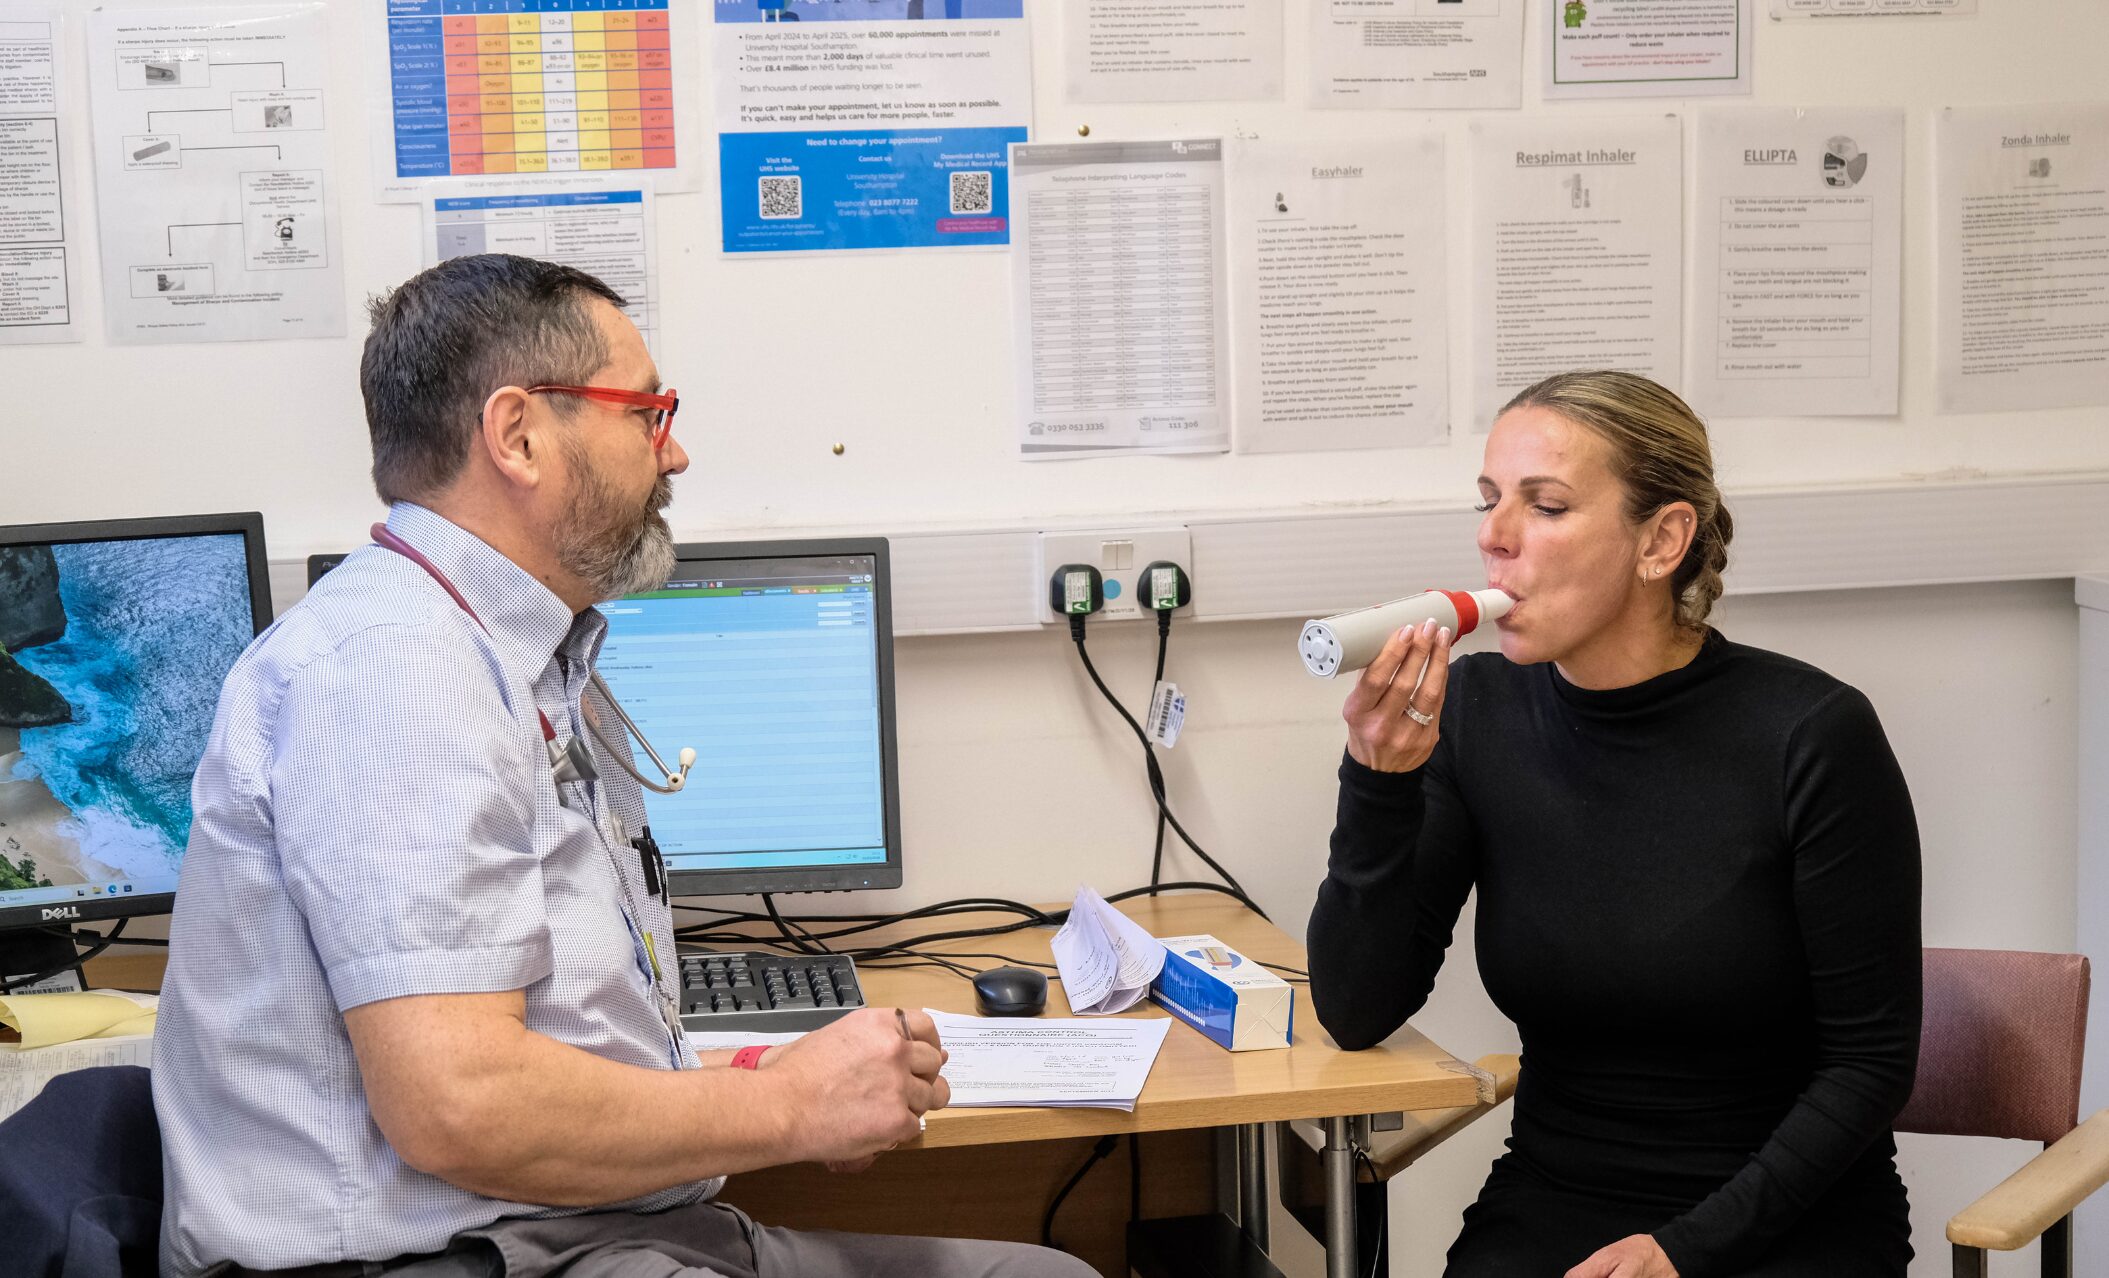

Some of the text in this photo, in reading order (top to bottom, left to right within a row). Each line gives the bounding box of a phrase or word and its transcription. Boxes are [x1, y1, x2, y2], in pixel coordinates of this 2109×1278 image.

[765, 33, 782, 42] April
[812, 32, 829, 41] April
[830, 32, 850, 40] 2025,
[868, 31, 894, 39] 60,000
[895, 30, 948, 40] appointments
[746, 44, 779, 52] University
[780, 43, 809, 52] Hospital
[846, 53, 864, 61] days
[836, 64, 863, 72] funding
[809, 84, 833, 92] people
[834, 83, 860, 92] waiting
[862, 83, 884, 91] longer
[828, 102, 880, 112] appointment,
[968, 100, 1001, 109] possible.
[754, 114, 777, 123] quick,
[815, 113, 836, 122] helps
[902, 111, 930, 120] people,
[839, 138, 867, 146] change
[888, 137, 942, 146] appointment?
[2002, 133, 2071, 146] Zonda Inhaler
[1516, 150, 1636, 166] Respimat Inhaler
[1744, 149, 1797, 162] ELLIPTA
[1052, 174, 1086, 183] Telephone
[1088, 173, 1128, 182] Interpreting
[1129, 172, 1163, 181] Language
[1312, 165, 1363, 178] Easyhaler
[42, 906, 80, 920] DELL
